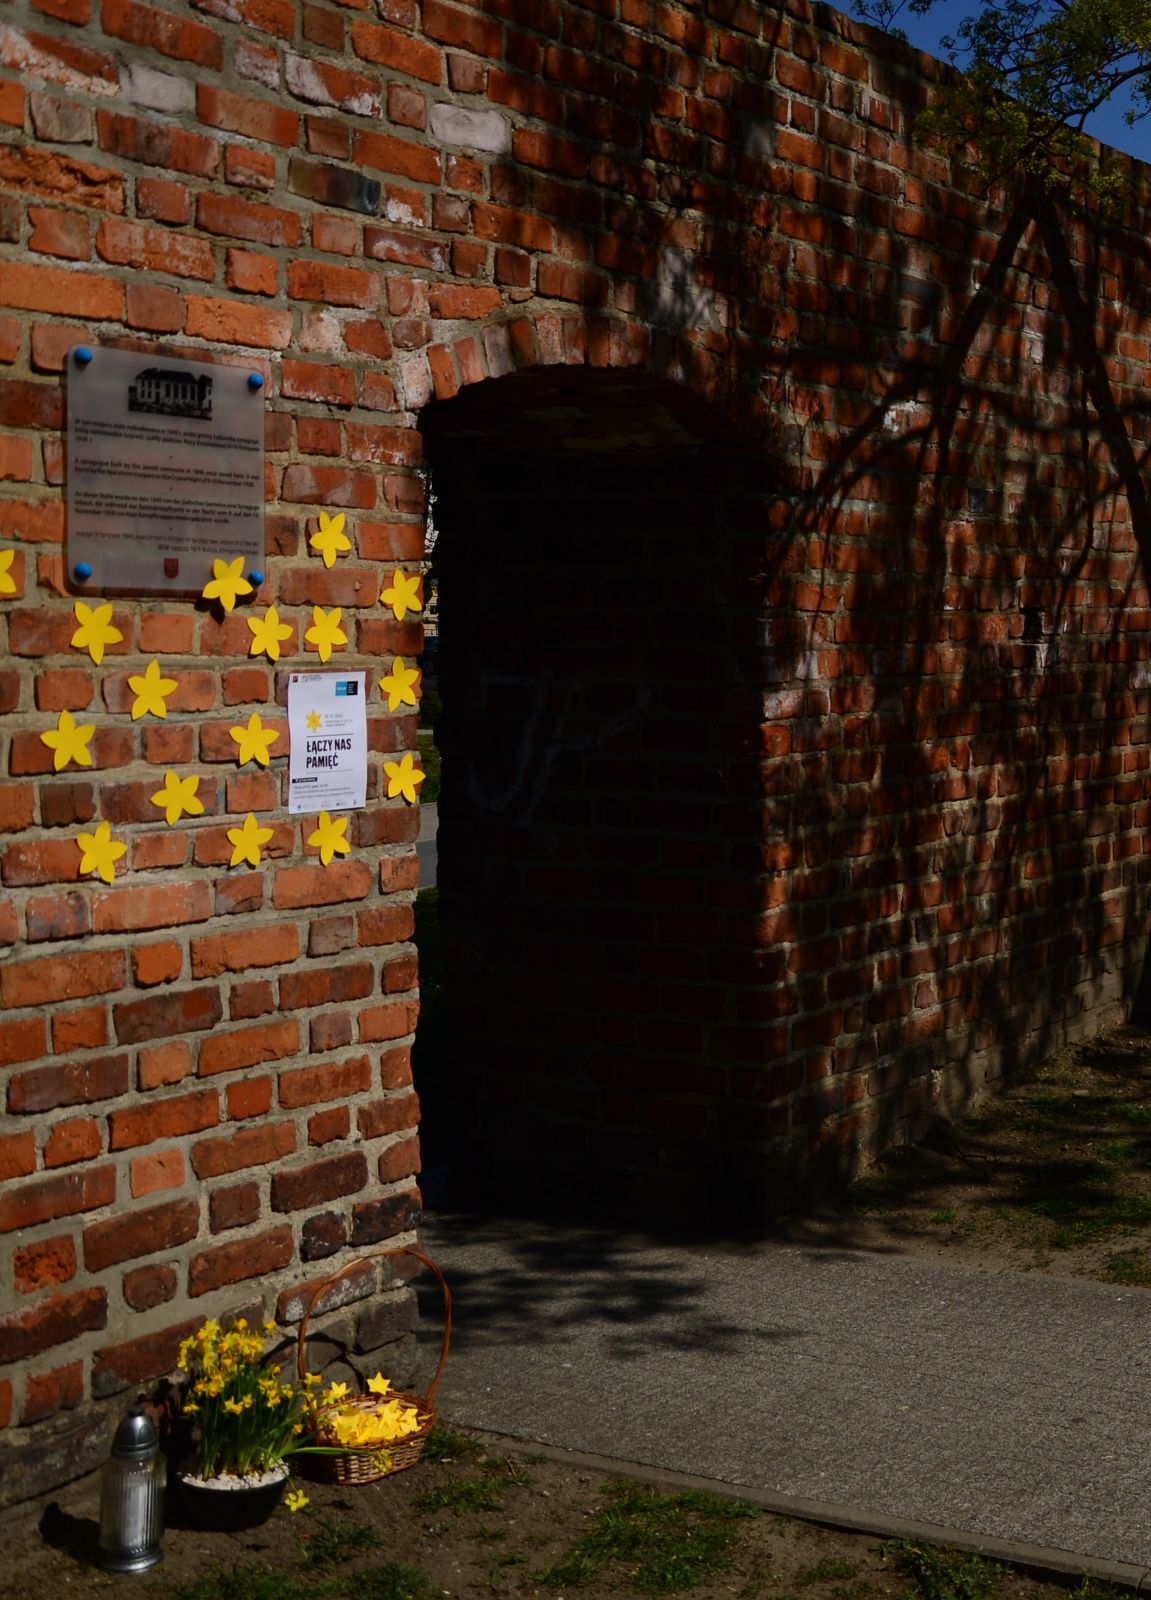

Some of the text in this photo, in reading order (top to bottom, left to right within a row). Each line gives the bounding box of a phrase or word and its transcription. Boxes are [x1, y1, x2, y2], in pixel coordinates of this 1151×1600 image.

[306, 738, 352, 755] ŁĄCZY NAS
[306, 752, 338, 769] PAMIĘĆ
